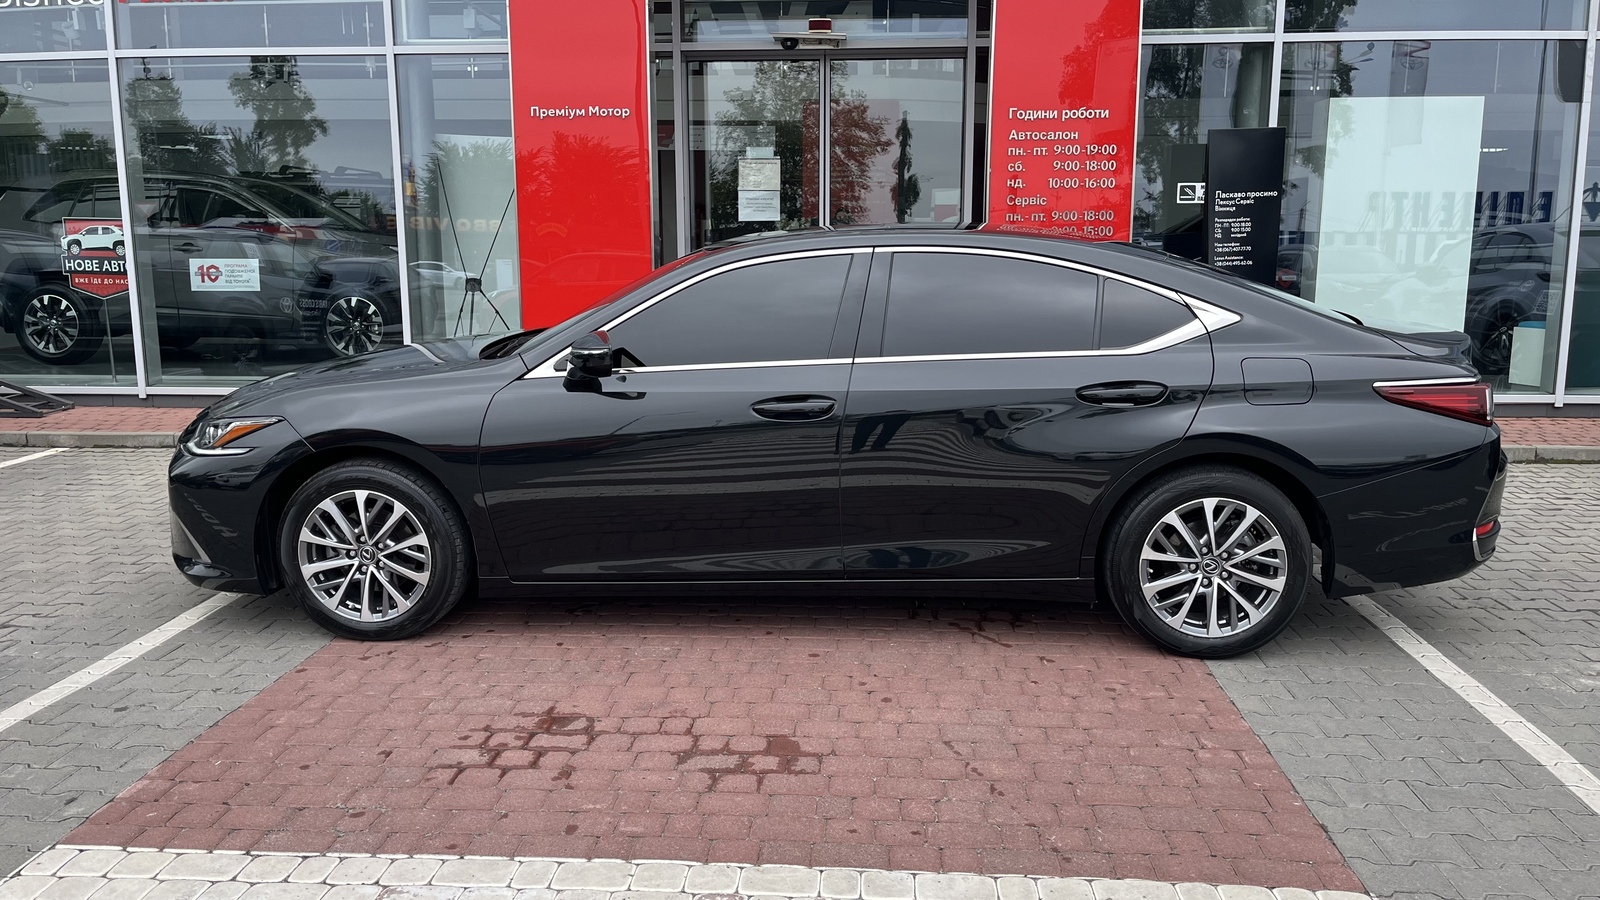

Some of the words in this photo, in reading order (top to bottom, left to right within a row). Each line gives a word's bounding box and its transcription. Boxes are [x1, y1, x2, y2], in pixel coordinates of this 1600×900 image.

[530, 106, 586, 119] Преміум
[588, 106, 630, 118] Мотор
[1008, 108, 1058, 121] Години
[1062, 107, 1109, 121] роботи
[1008, 130, 1078, 140] Автосалон
[1054, 144, 1117, 156] 9:00-19:00
[1008, 161, 1026, 172] сб.
[1053, 160, 1116, 171] 9:00-18:00
[1006, 178, 1026, 188] нд.
[1048, 178, 1116, 188] 10:00-16:00
[1215, 190, 1246, 198] Ласкаво
[1006, 195, 1048, 207] Сервіс
[1052, 210, 1114, 222] 9:00-18:00
[65, 259, 100, 271] НОВЕ
[102, 260, 128, 272] АВТ
